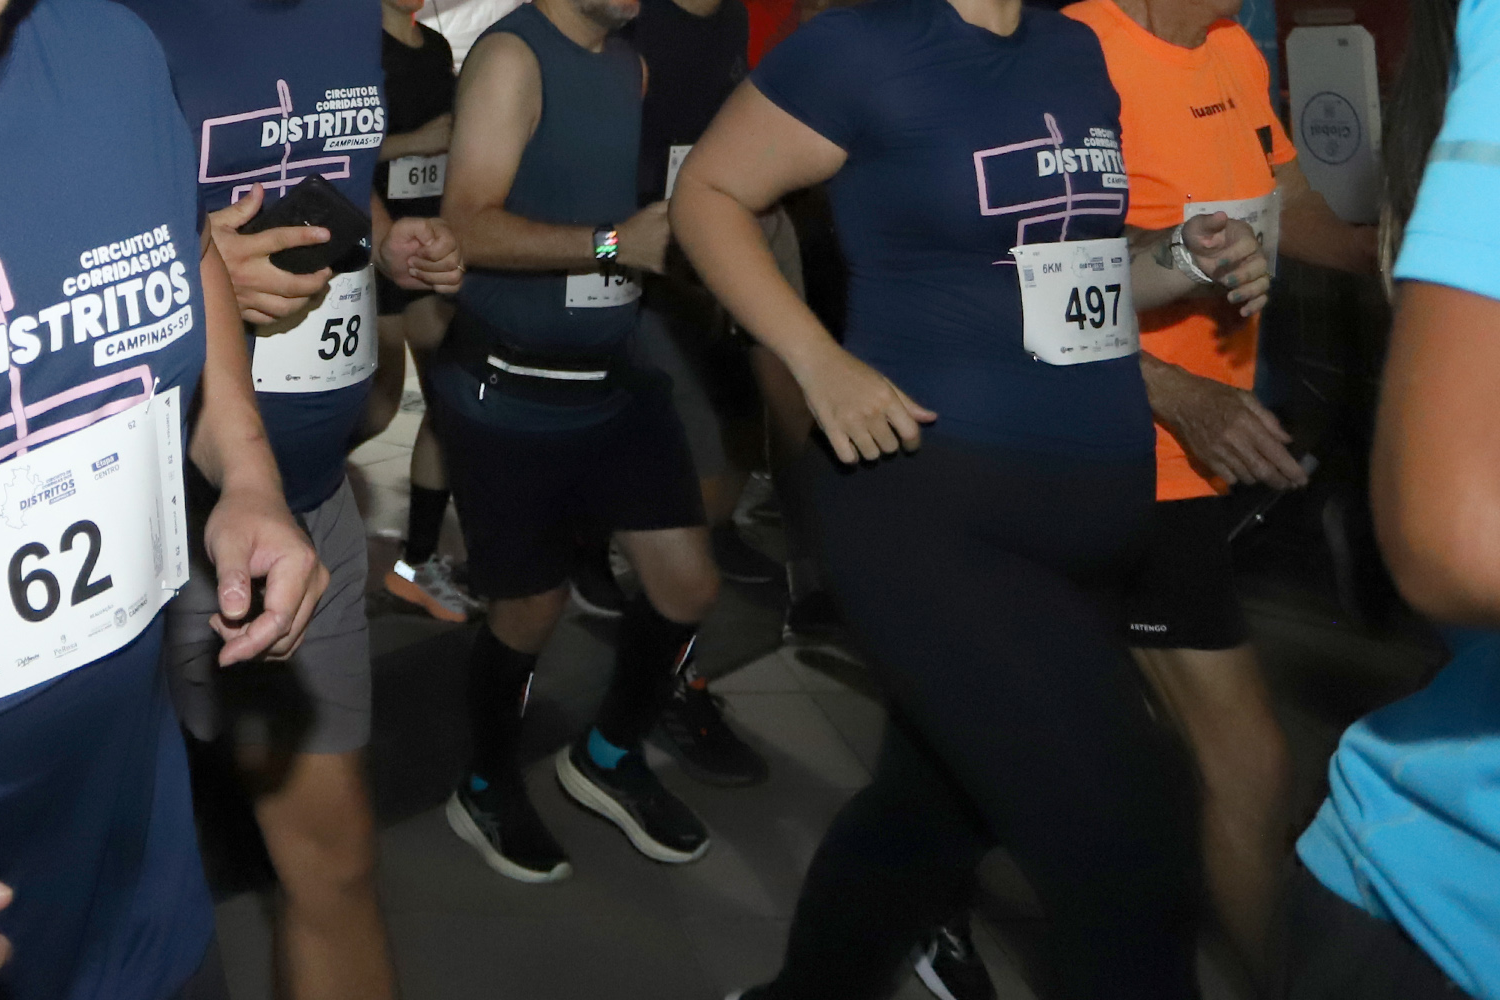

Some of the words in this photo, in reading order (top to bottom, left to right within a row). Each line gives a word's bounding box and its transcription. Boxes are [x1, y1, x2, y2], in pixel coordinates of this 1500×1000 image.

[325, 88, 367, 99] CIRCUITO
[368, 85, 378, 96] DE
[315, 97, 363, 112] CORRIDAS
[363, 96, 380, 107] DOS
[261, 106, 384, 148] DISTRITOS
[329, 136, 380, 148] CAMPINAS-SP
[408, 164, 438, 186] 618
[80, 231, 155, 269] CIRCUITO
[152, 224, 171, 246] DE
[63, 253, 151, 296] CORRIDAS
[149, 242, 177, 268] DOS
[1042, 262, 1063, 274] 6KM
[1065, 284, 1122, 330] 497
[105, 313, 190, 357] CAMPINAS-SP
[318, 314, 362, 361] 58
[128, 420, 137, 430] 62
[94, 464, 120, 480] CENTRO
[95, 455, 115, 469] Etapa
[19, 478, 75, 511] DISTRITOS
[8, 519, 114, 623] 62
[1130, 624, 1167, 632] ARTENGO
